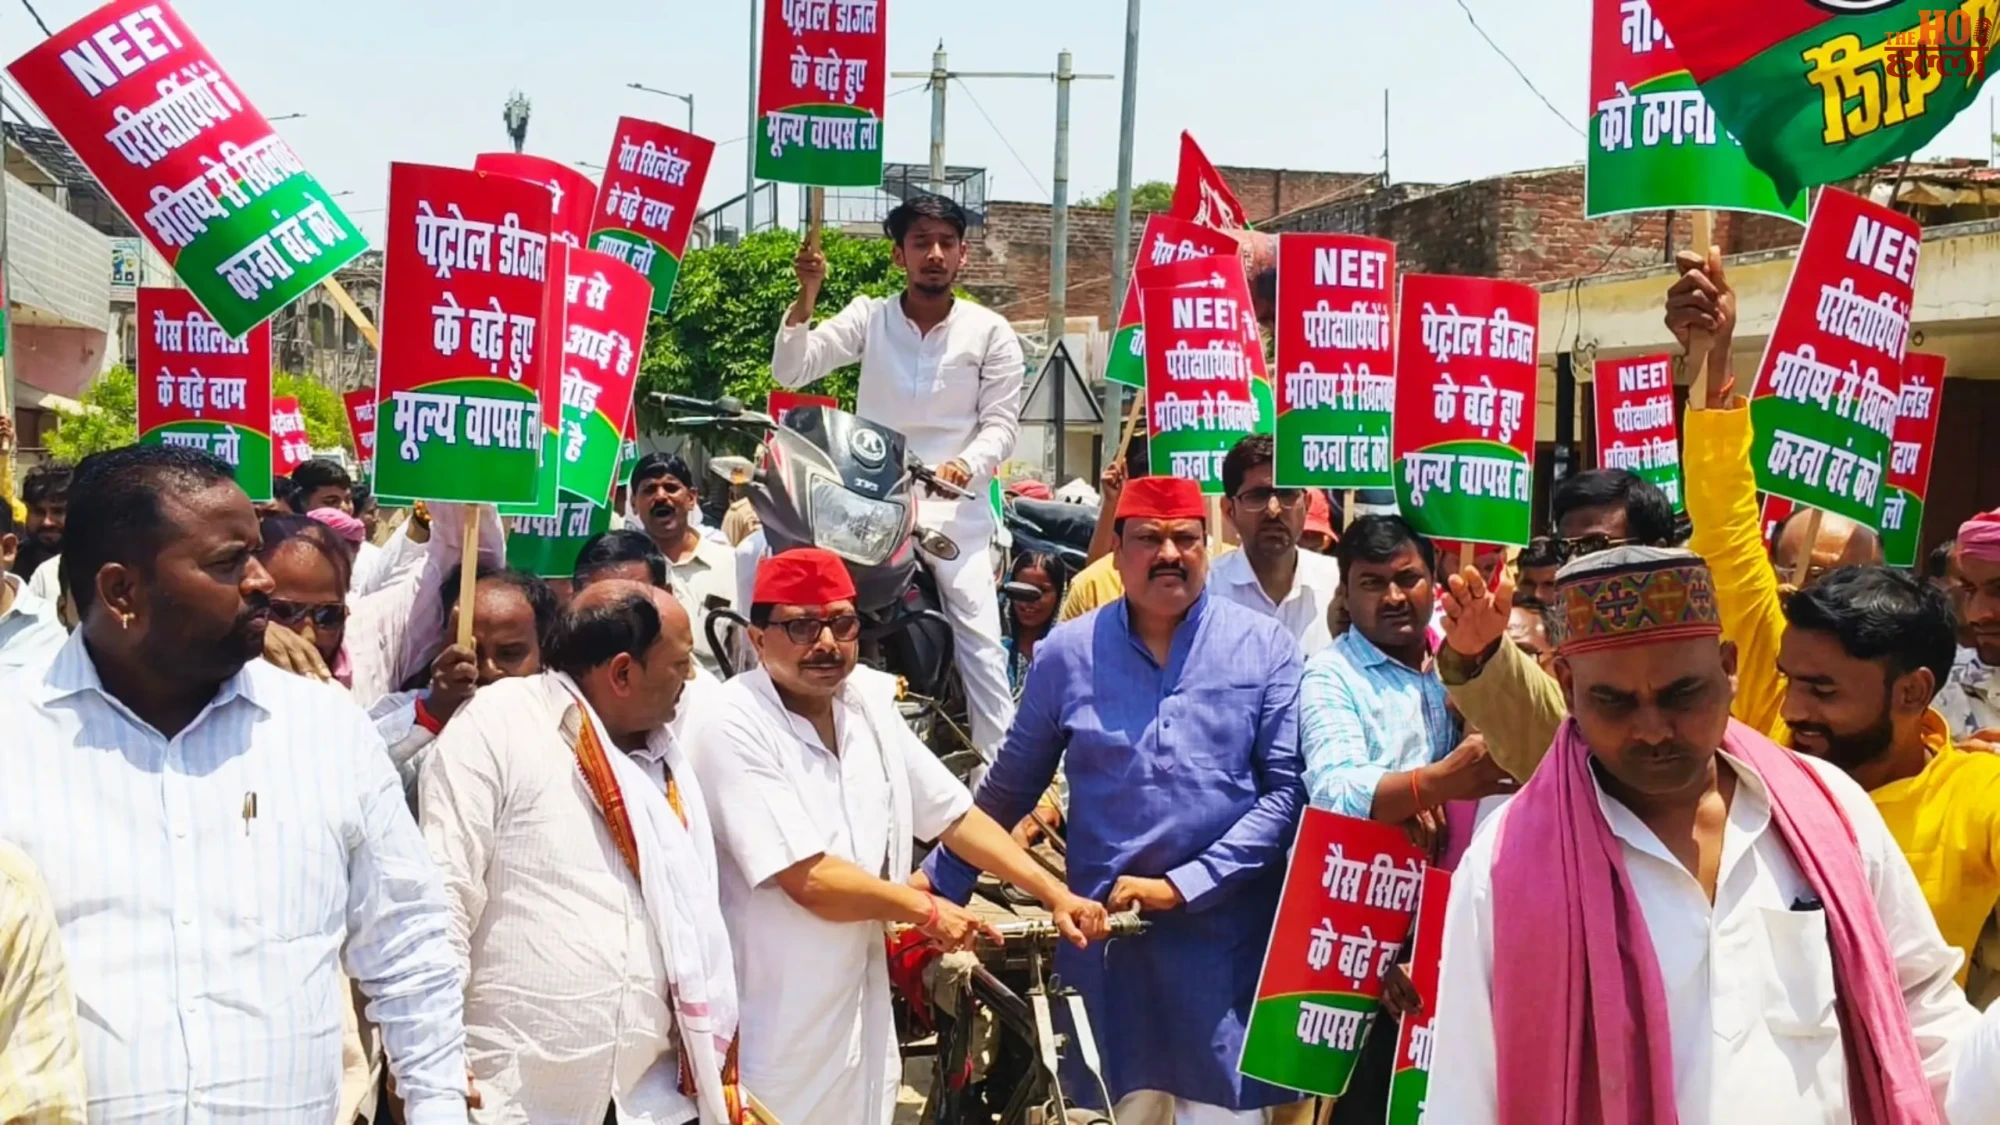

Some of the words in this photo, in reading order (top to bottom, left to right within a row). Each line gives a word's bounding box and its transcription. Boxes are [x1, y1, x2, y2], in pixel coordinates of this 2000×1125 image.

[60, 4, 183, 98] NEET
[790, 45, 811, 88] के
[814, 48, 842, 100] बढ़े
[845, 59, 867, 104] हुए
[766, 110, 808, 157] मूल्य
[810, 115, 857, 150] वापस
[860, 108, 879, 150] लो
[1597, 82, 1637, 151] को
[1640, 90, 1717, 146] ठगना
[617, 135, 640, 172] गैस
[637, 140, 691, 187] सिलेंडर
[144, 185, 230, 248] भविष्य
[606, 181, 621, 216] के
[619, 186, 642, 228] बढ़े
[641, 198, 675, 232] दाम
[215, 234, 294, 300] करना
[270, 209, 322, 264] बंद
[416, 200, 494, 279] पेट्रोल
[497, 212, 547, 282] डीजल
[632, 238, 657, 275] लो
[1314, 247, 1386, 289] NEET
[584, 272, 612, 311] से
[1172, 297, 1238, 331] NEET
[153, 310, 183, 351] गैस
[432, 291, 463, 356] के
[469, 296, 504, 374] बढ़े
[509, 314, 536, 381] हुए
[1421, 302, 1487, 363] पेट्रोल
[1488, 307, 1535, 365] डीजल
[156, 366, 175, 407] के
[178, 368, 206, 417] बढ़े
[209, 378, 247, 410] दाम
[1285, 361, 1339, 410] भविष्य
[1340, 362, 1357, 411] से
[1618, 361, 1668, 392] NEET
[1769, 344, 1841, 417] भविष्य
[1835, 359, 1861, 418] से
[391, 391, 461, 462] मूल्य
[464, 396, 522, 449] वापस
[1154, 391, 1200, 432] भविष्य
[1200, 390, 1215, 431] से
[1433, 372, 1460, 423] के
[1462, 375, 1498, 437] बढ़े
[1498, 388, 1524, 443] हुए
[1302, 434, 1347, 473] करना
[1348, 424, 1370, 472] बंद
[1767, 428, 1830, 487] करना
[1825, 437, 1854, 497] बंद
[1852, 451, 1882, 508] करो
[1403, 452, 1456, 508] मूल्य
[1458, 455, 1513, 500] वापस
[1881, 489, 1907, 530] लो
[1321, 843, 1367, 903] गैस
[1307, 917, 1338, 971] के
[1337, 925, 1377, 990] बढ़े
[1296, 1000, 1363, 1051] वापस
